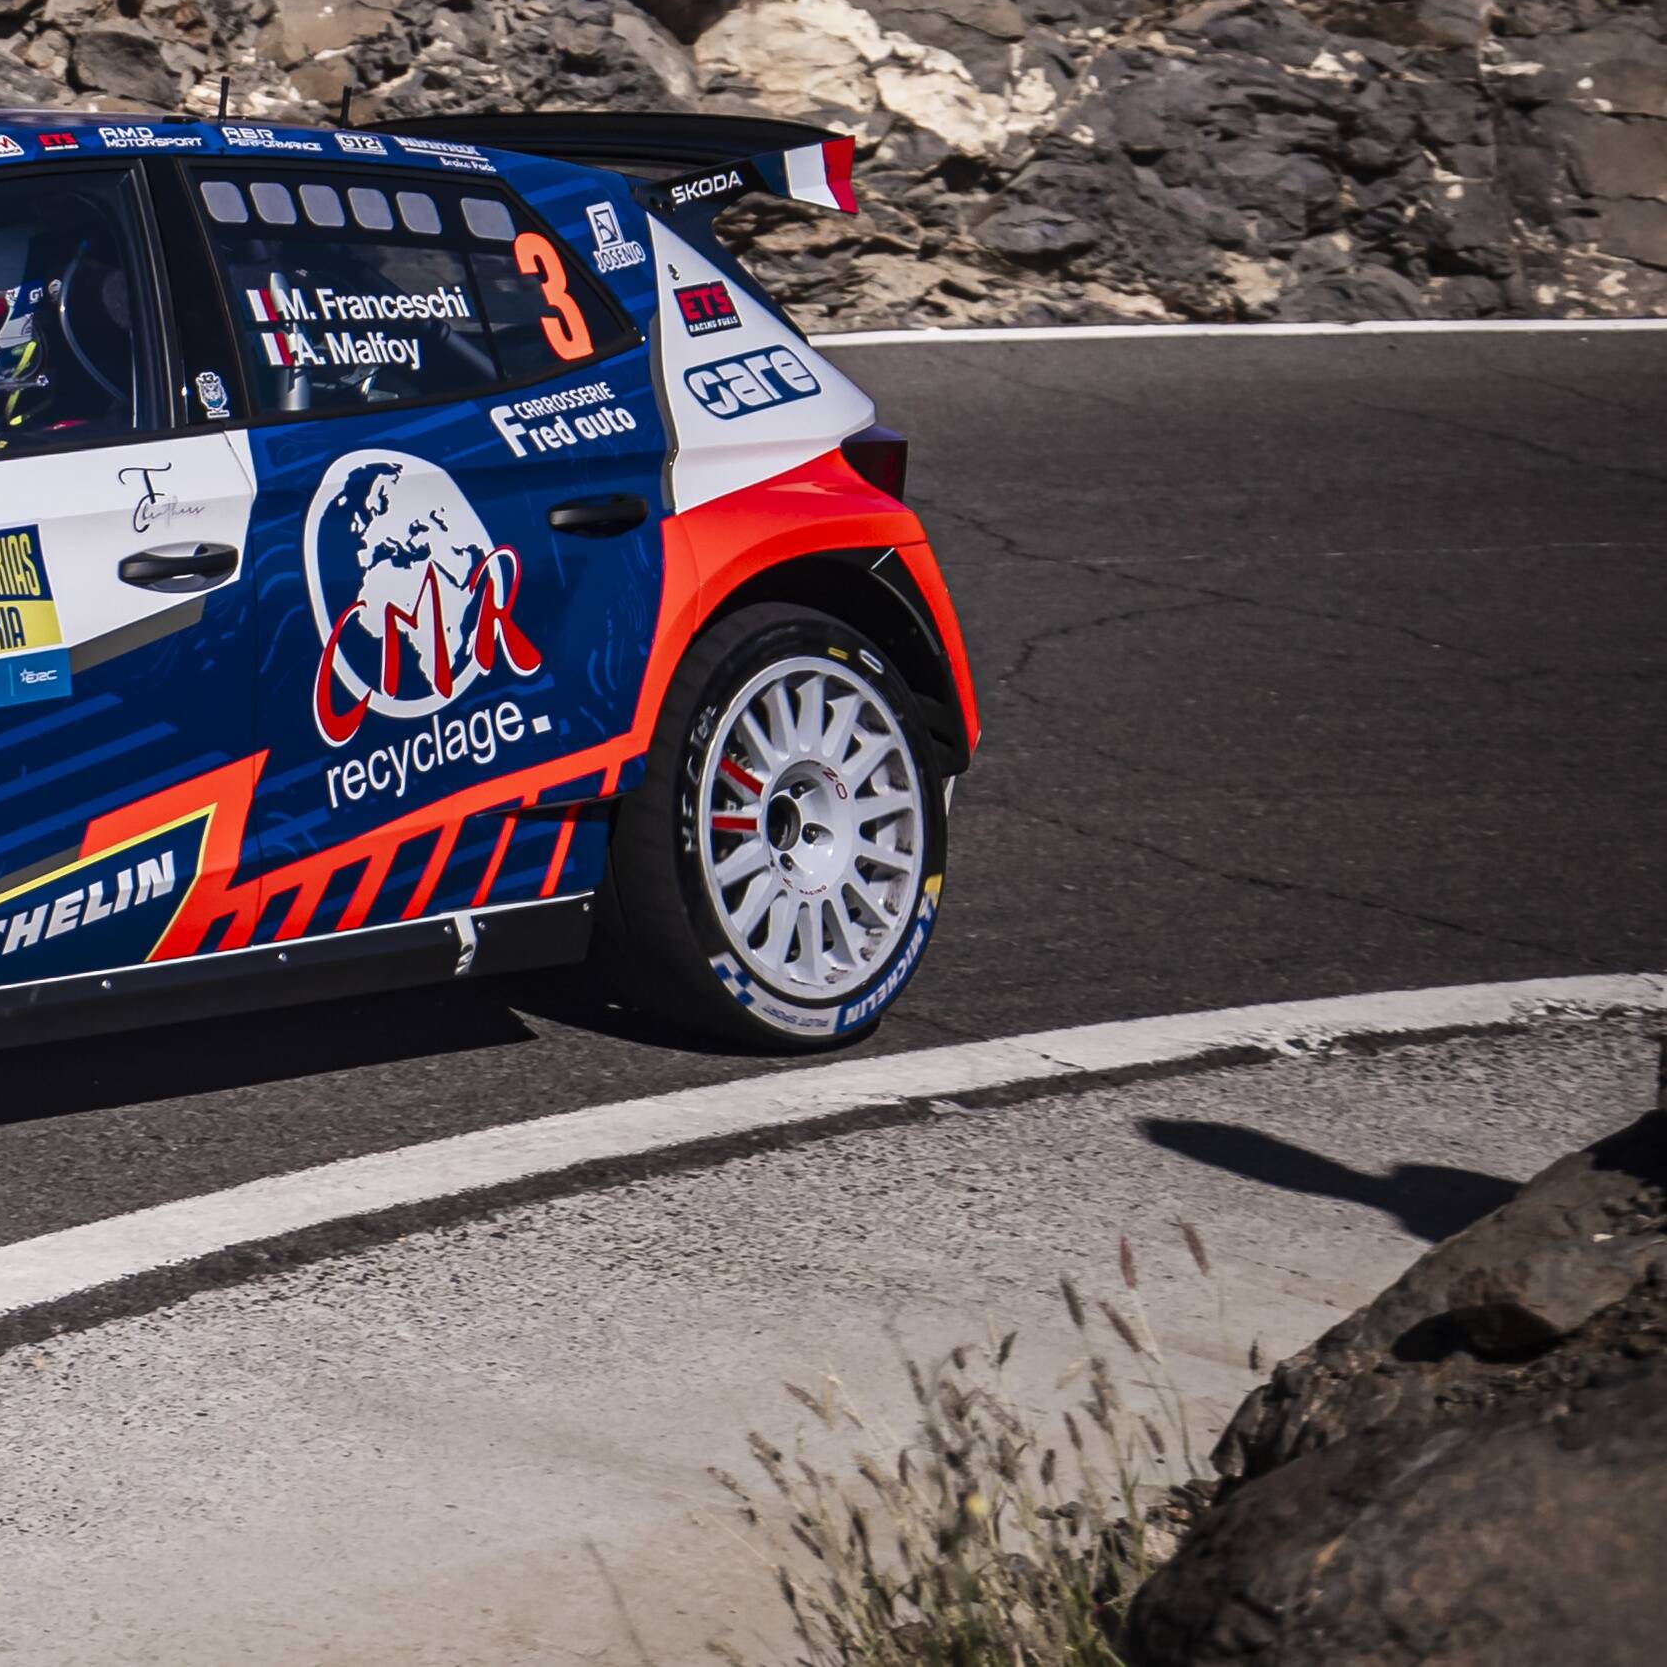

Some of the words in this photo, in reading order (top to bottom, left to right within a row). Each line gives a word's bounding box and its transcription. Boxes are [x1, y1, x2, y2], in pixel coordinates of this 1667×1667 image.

[104, 136, 204, 149] MOTORSPORT
[279, 289, 317, 321] M.
[316, 286, 471, 321] Franceschi
[514, 232, 594, 360] 3
[680, 285, 734, 321] ETS
[689, 320, 717, 333] RACING
[296, 332, 327, 366] A.
[325, 331, 420, 371] Malfoy
[513, 381, 617, 421] CARROSSERIE
[490, 405, 578, 459] Fred
[575, 406, 637, 442] auto
[314, 544, 543, 748] CMR
[844, 922, 925, 1027] MICHELIN
